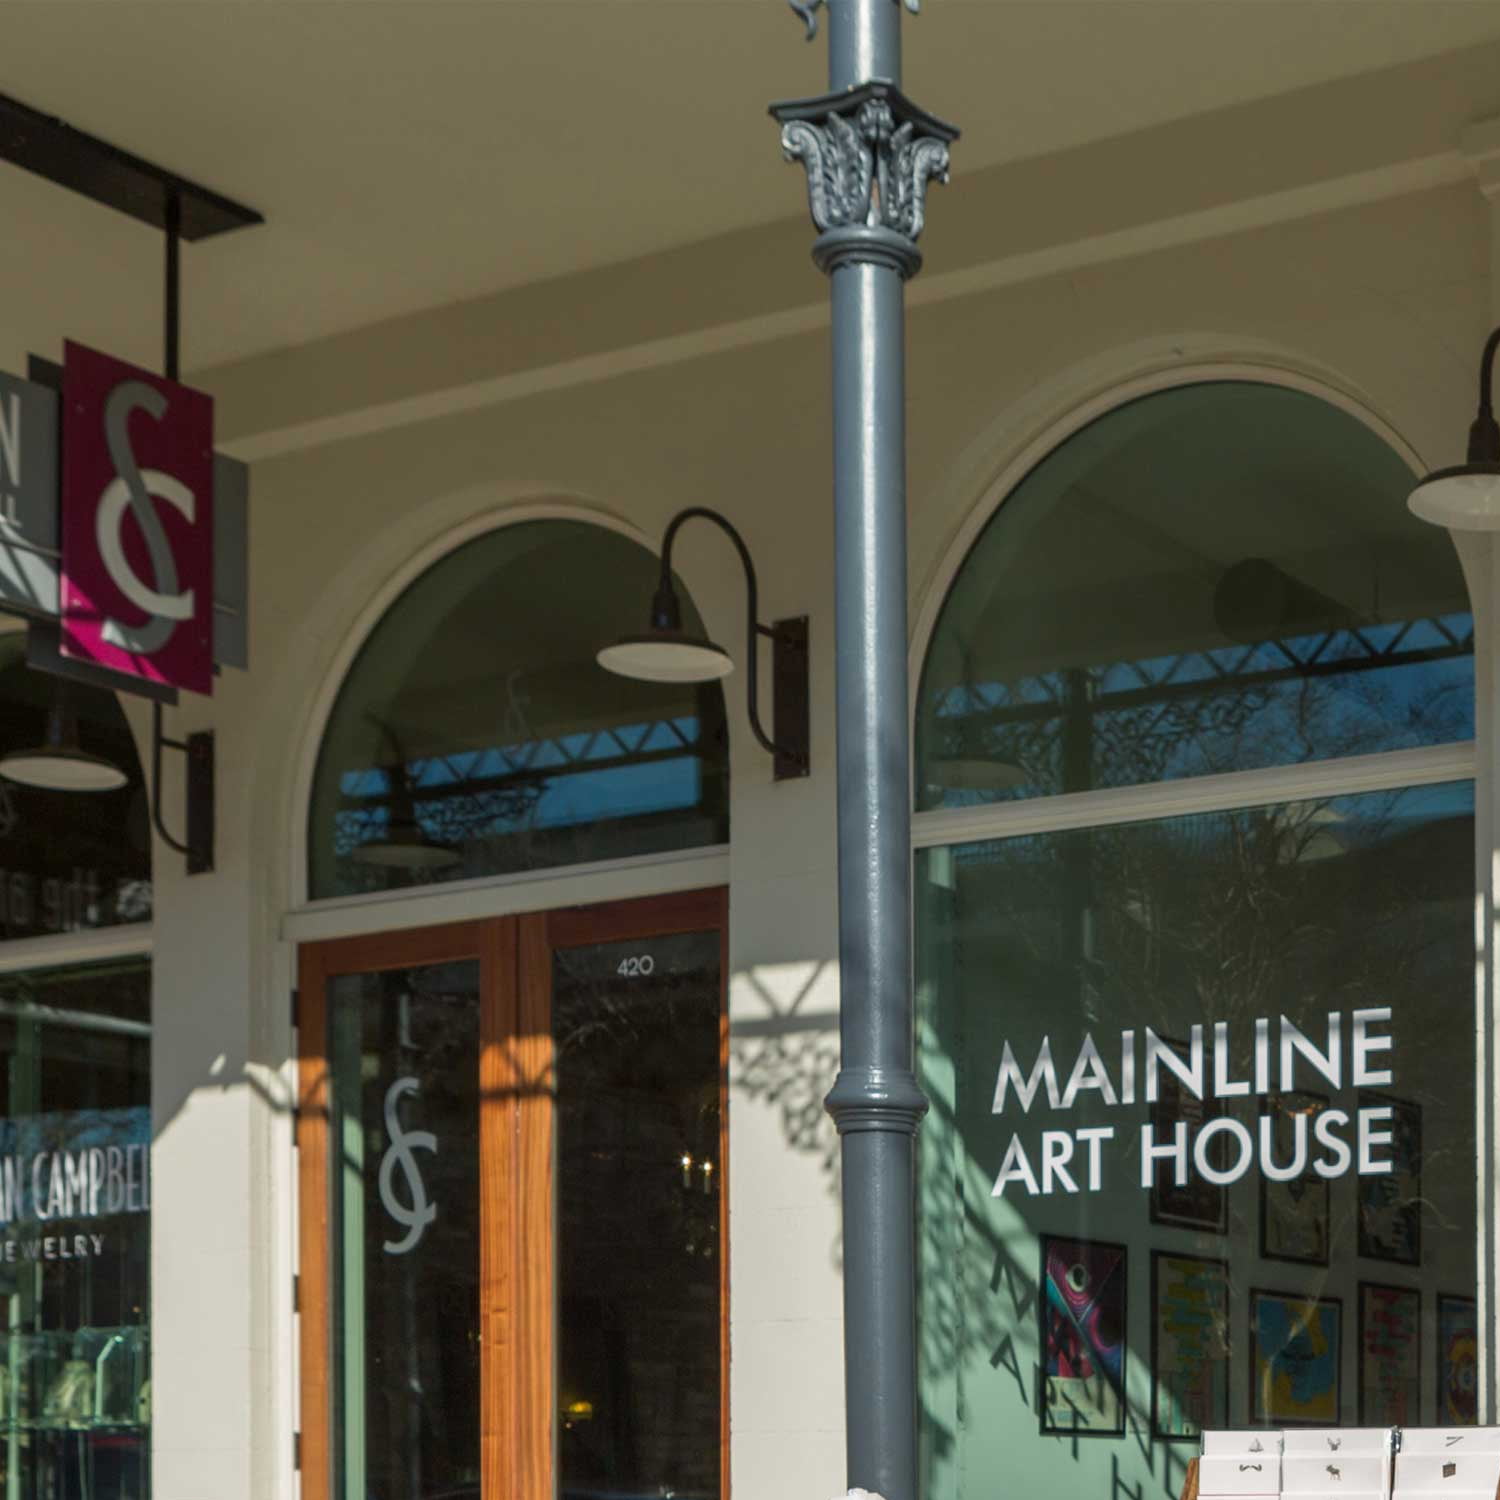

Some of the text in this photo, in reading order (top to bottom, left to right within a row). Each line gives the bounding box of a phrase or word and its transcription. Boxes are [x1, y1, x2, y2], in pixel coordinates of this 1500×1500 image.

[617, 955, 654, 978] 420
[991, 1007, 1392, 1114] MAINLINE
[991, 1107, 1392, 1197] ART HOUSE
[0, 1234, 104, 1262] EWELRY
